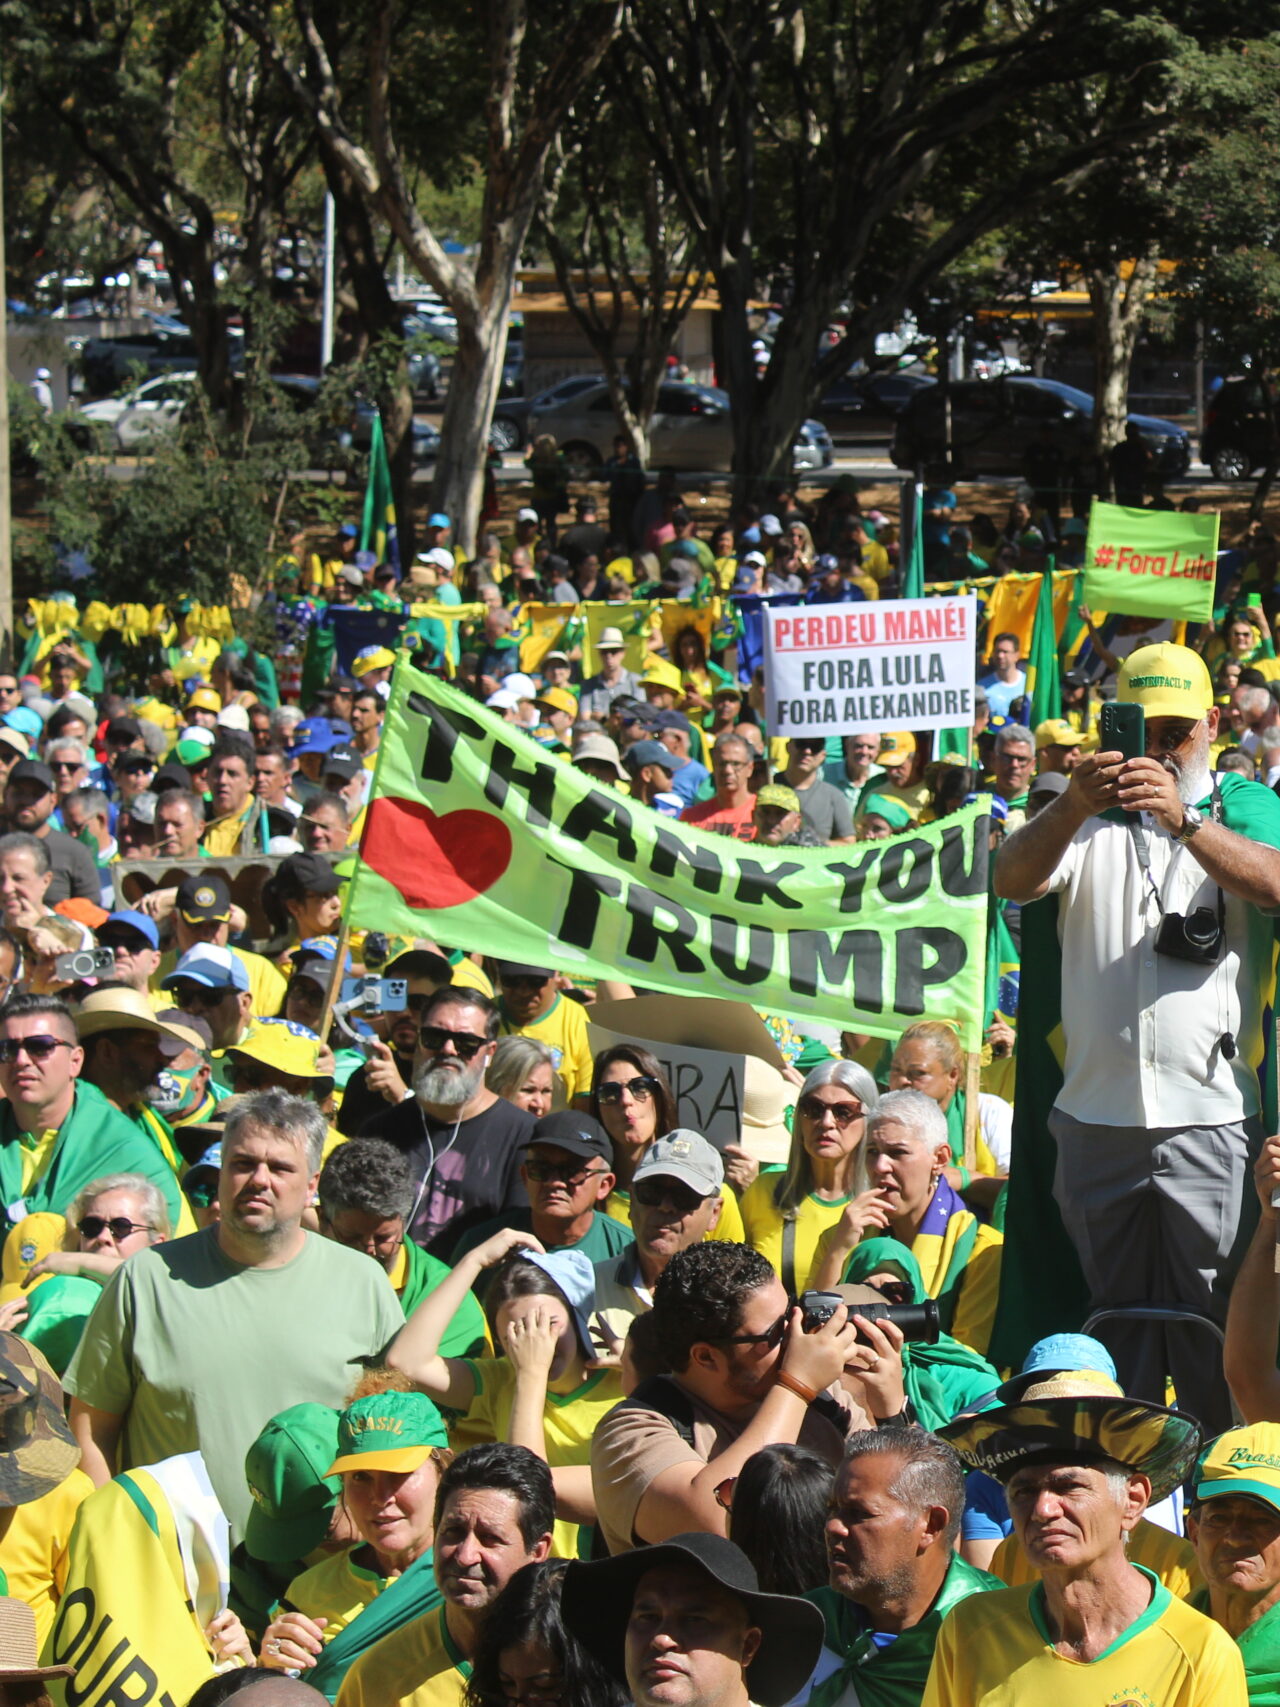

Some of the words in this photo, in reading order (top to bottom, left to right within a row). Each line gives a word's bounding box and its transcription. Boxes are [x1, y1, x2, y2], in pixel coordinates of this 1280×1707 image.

[1094, 544, 1167, 577] #Fora
[1169, 551, 1216, 581] Lula
[774, 613, 875, 648] PERDEU
[884, 602, 966, 641] MANÉ!
[803, 657, 874, 691] FORA
[882, 653, 946, 687] LULA
[777, 698, 838, 725] FORA
[843, 689, 971, 721] ALEXANDRE
[407, 691, 805, 910] THANK
[828, 814, 990, 914] YOU
[545, 853, 968, 1017] TRUMP
[659, 1060, 742, 1141] RA
[53, 1586, 178, 1707] OUR
